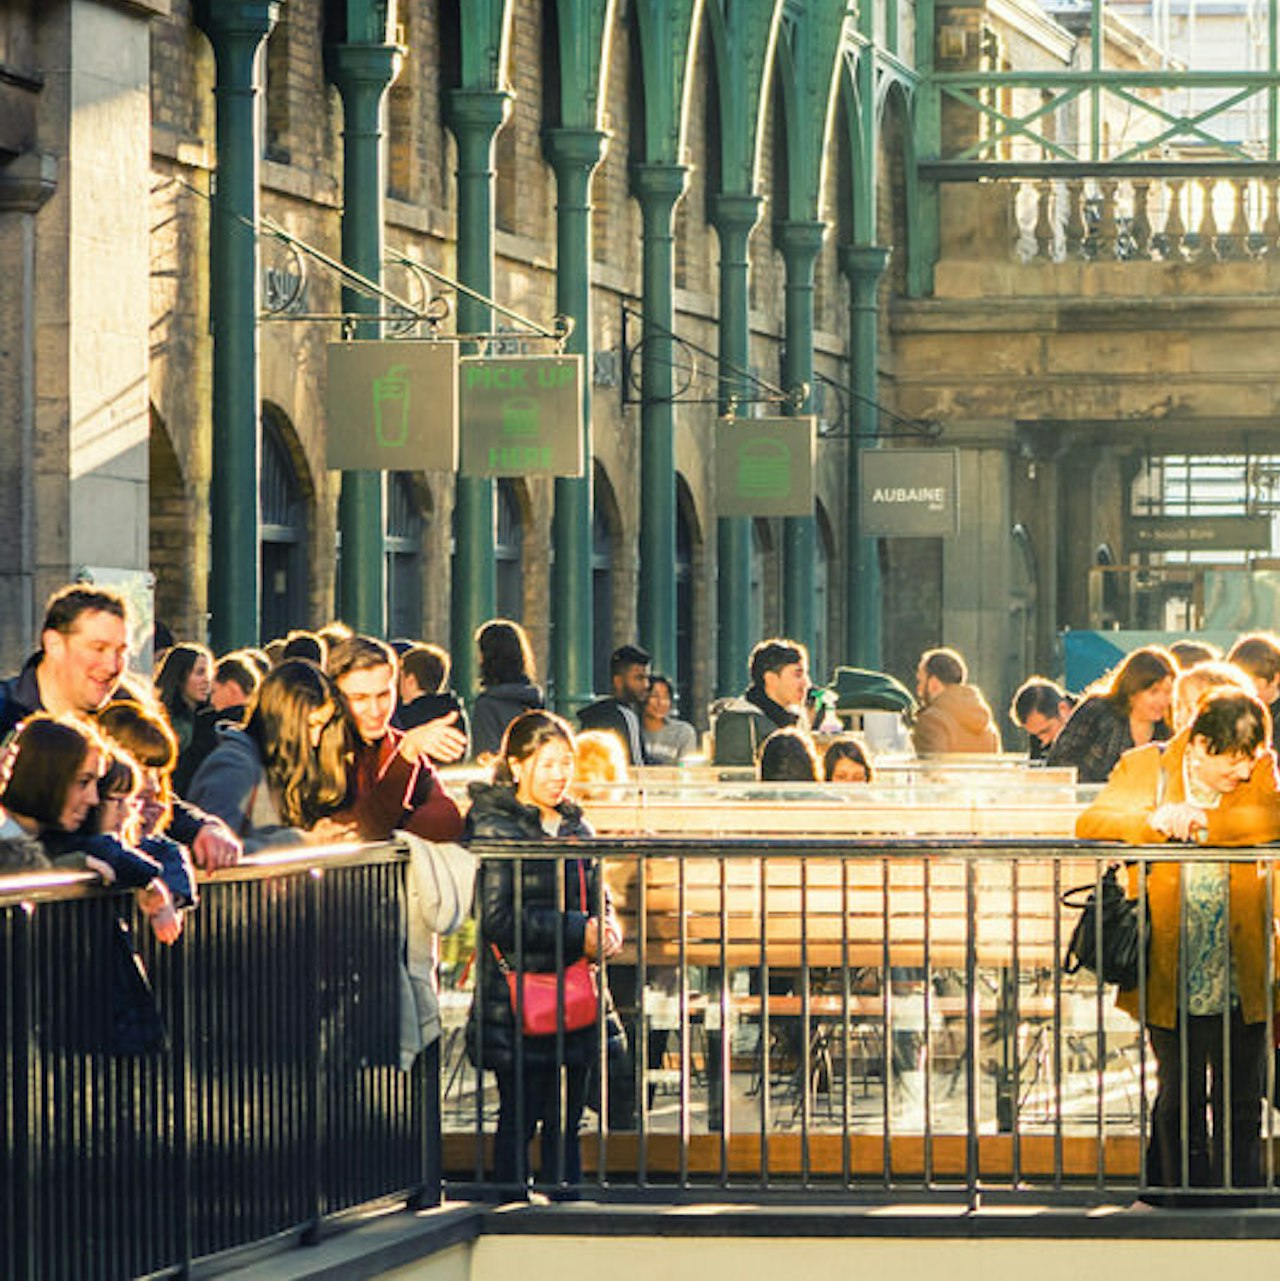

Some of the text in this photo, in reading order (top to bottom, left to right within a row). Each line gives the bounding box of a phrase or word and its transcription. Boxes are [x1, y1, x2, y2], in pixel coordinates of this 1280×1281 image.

[465, 366, 575, 389] PICK UP
[488, 447, 552, 468] HERE
[872, 487, 944, 503] AUBAINE
